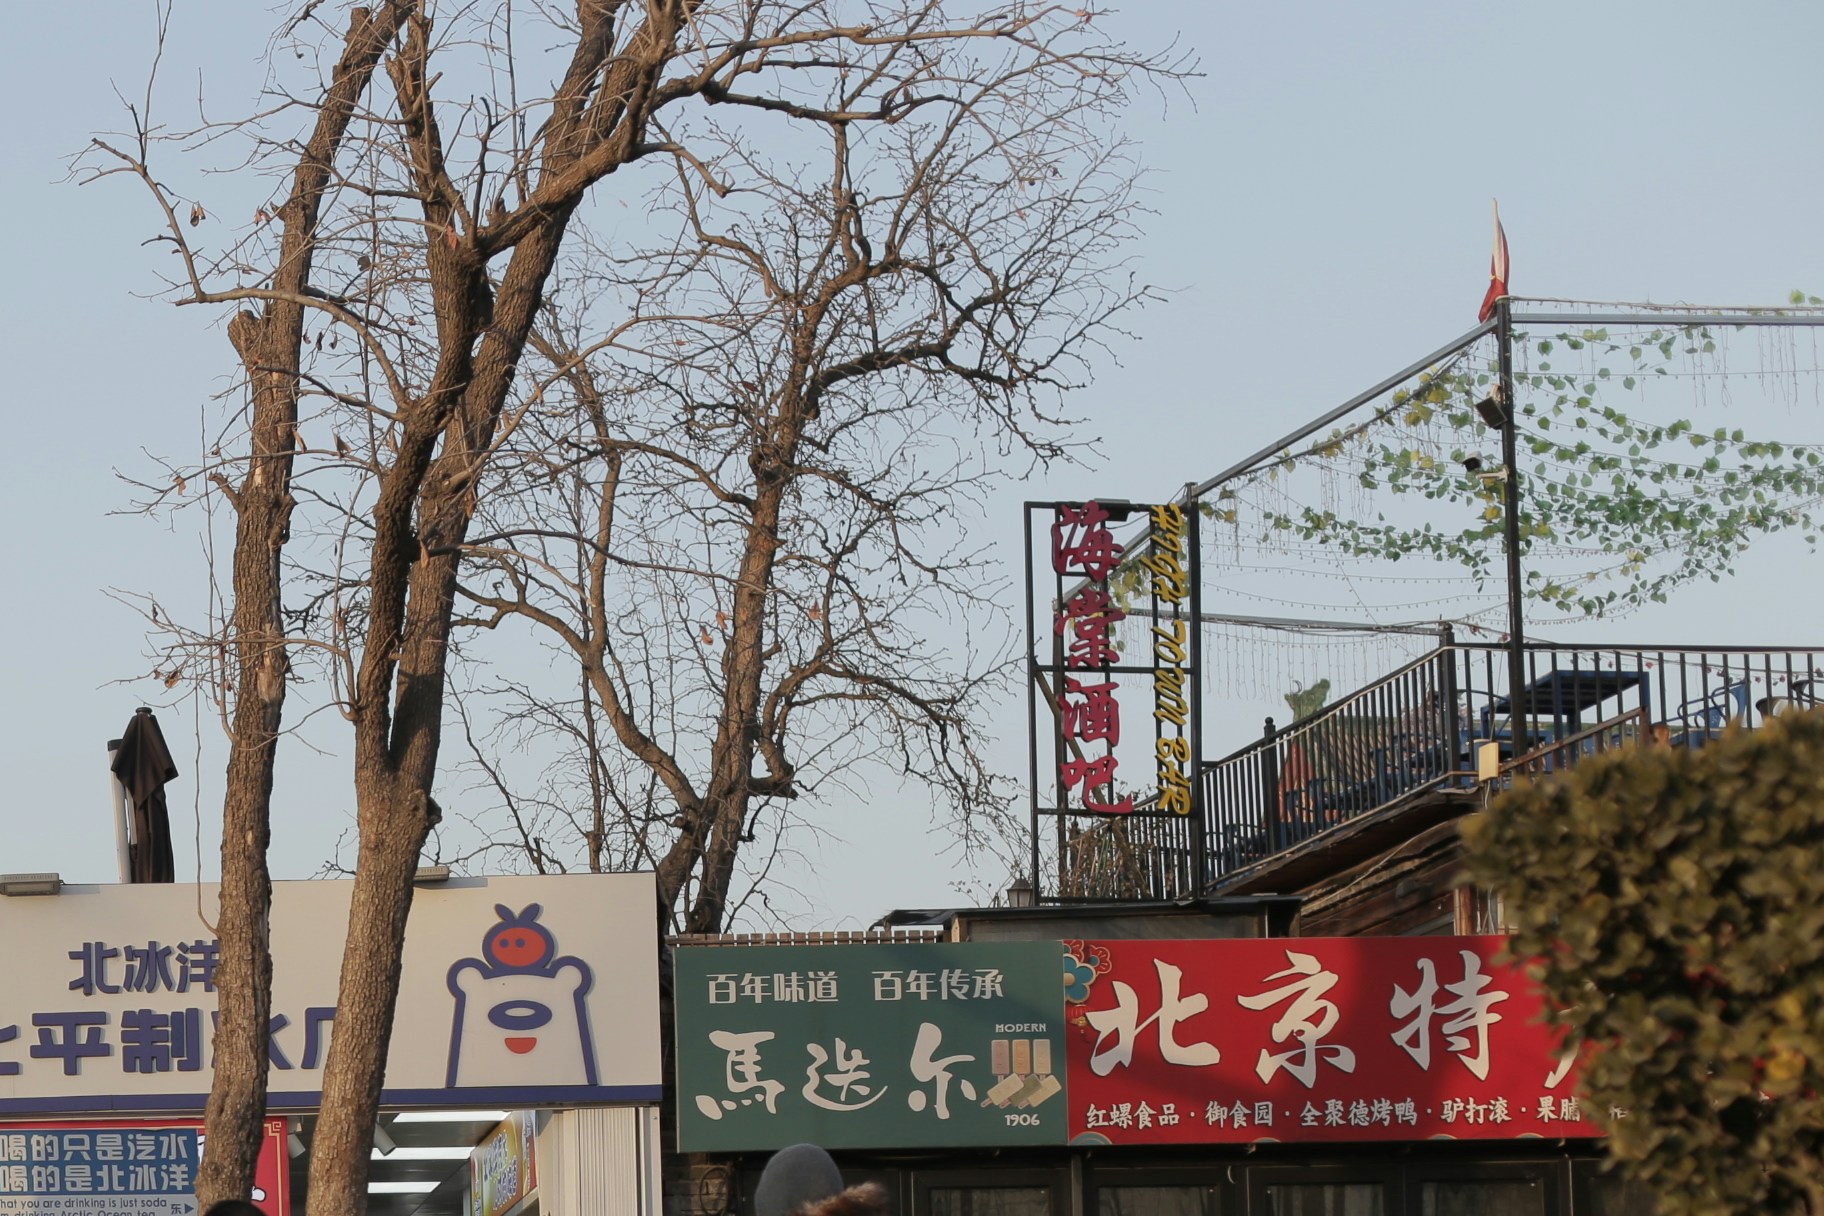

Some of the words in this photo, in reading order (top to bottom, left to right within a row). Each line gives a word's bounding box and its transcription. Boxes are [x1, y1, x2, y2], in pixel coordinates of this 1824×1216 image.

[1052, 500, 1133, 814] 海棠酒吧
[1155, 736, 1191, 815] BAR
[68, 939, 221, 996] 北冰洋
[705, 970, 839, 1004] 百年味道
[871, 968, 1005, 1001] 百年传承
[995, 1023, 1047, 1033] MODERN
[1085, 948, 1579, 1090] 北京特
[1004, 1114, 1041, 1127] 1906
[1086, 1100, 1180, 1130] 红螺食品
[1205, 1100, 1273, 1129] 御食园
[1299, 1097, 1418, 1127] 全聚德烤鸭
[1441, 1096, 1512, 1124] 驴打滚
[21, 1201, 42, 1211] you
[43, 1200, 61, 1208] are
[64, 1198, 105, 1210] drinking
[108, 1199, 118, 1208] is
[119, 1199, 138, 1209] just
[141, 1198, 167, 1208] soda
